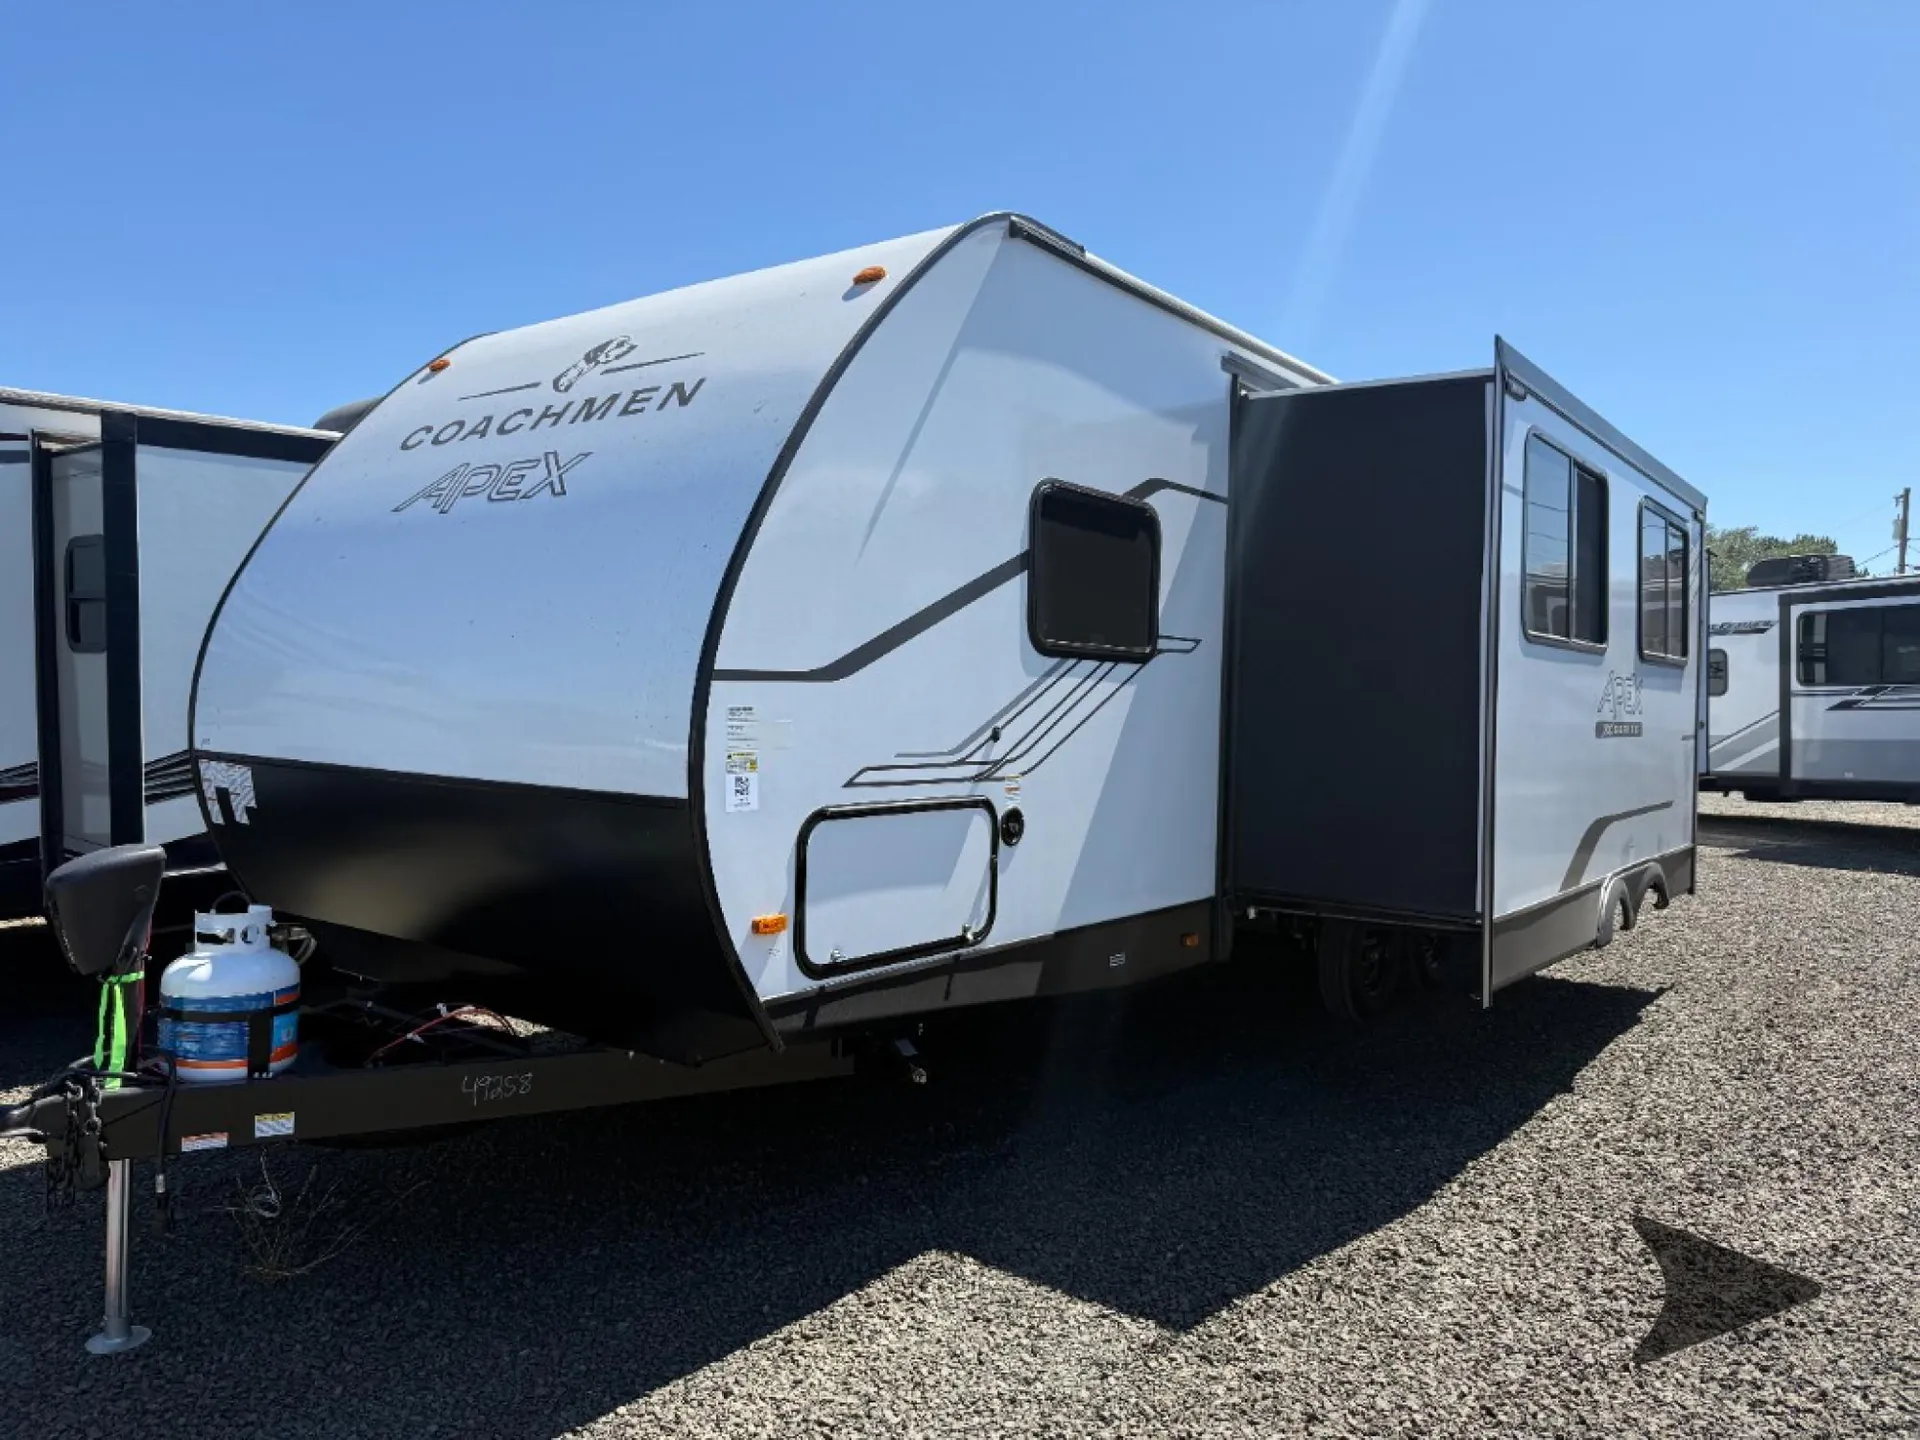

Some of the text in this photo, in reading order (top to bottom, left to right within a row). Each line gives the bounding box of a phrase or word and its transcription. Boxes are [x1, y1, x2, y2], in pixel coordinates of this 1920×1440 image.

[400, 377, 706, 451] COACHMEN
[391, 450, 594, 514] APEX
[1597, 669, 1643, 720] APEX
